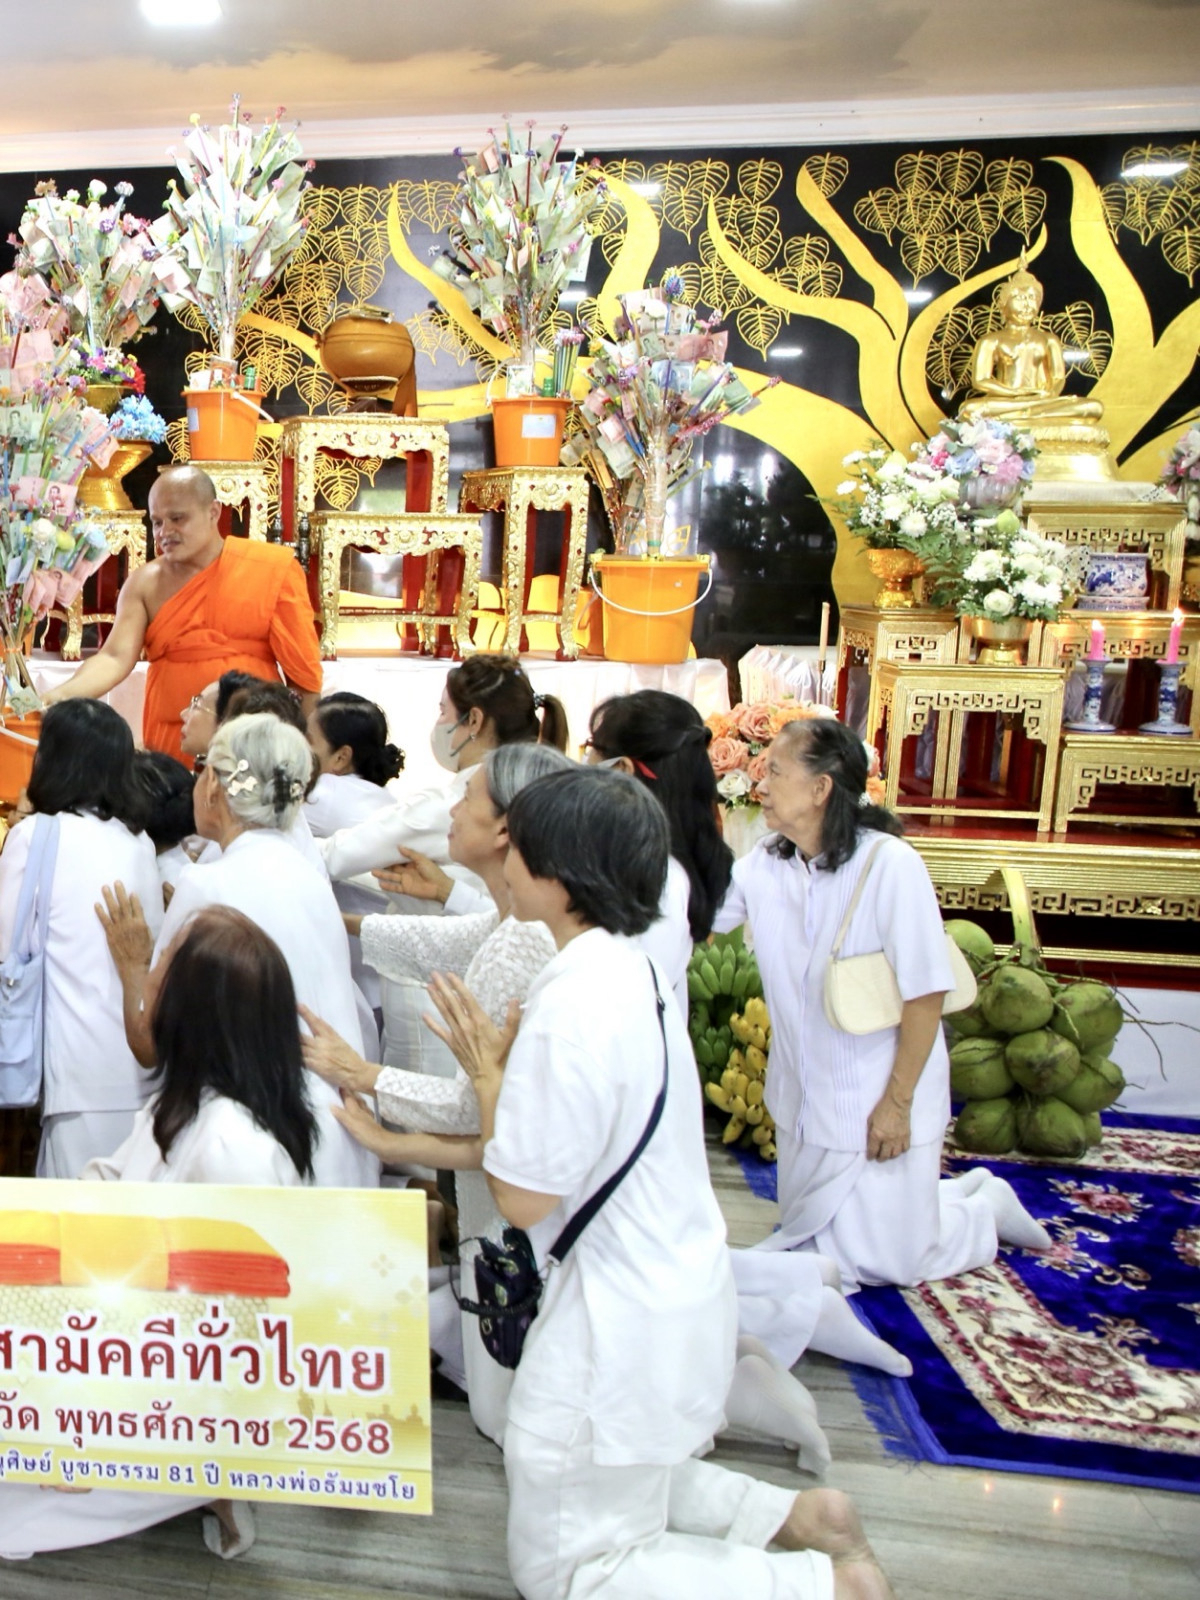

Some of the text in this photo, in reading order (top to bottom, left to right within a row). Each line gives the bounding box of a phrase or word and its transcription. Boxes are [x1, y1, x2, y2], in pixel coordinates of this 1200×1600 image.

[55, 1401, 270, 1449] พุทธศักราช
[287, 1417, 390, 1455] 2568
[61, 1459, 159, 1482] บูชาธรรม
[169, 1465, 195, 1483] 81
[204, 1462, 220, 1485] ปี
[229, 1469, 415, 1500] หลวงพ่อธัมมชโย
